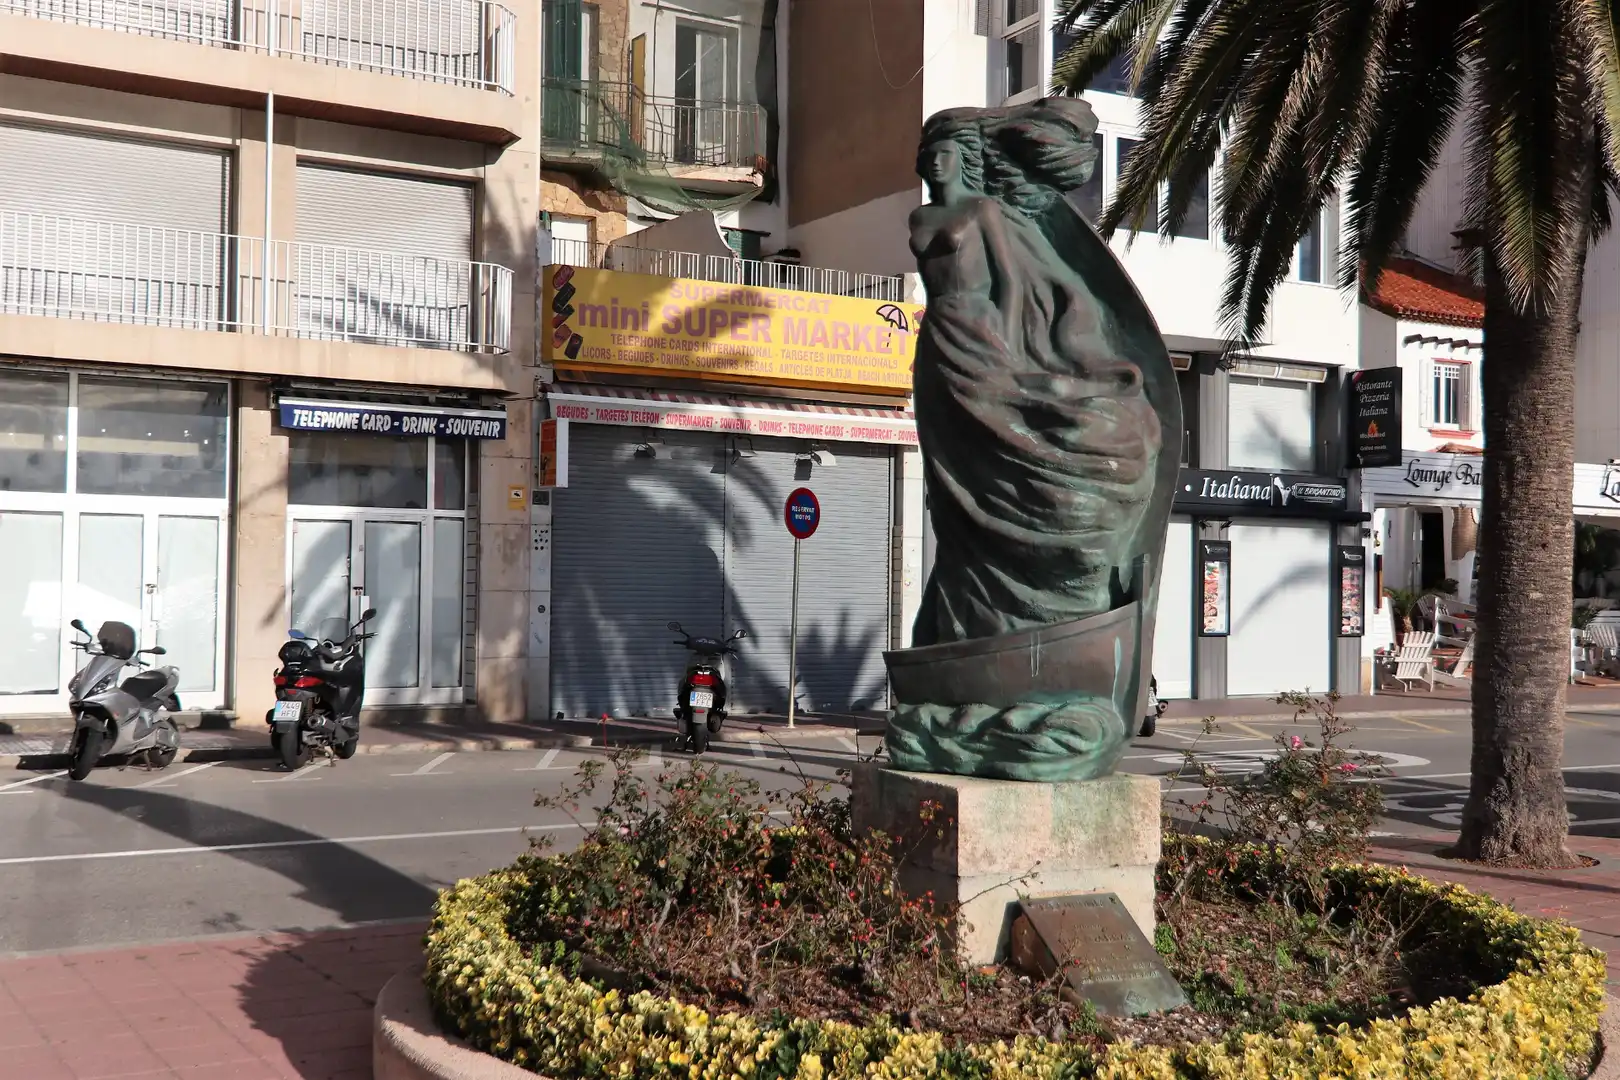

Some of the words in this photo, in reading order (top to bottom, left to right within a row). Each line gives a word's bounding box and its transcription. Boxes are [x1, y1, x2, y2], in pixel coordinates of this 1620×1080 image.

[670, 282, 832, 314] SUPERMERCAT
[578, 298, 649, 332] mini
[662, 304, 772, 343] SUPER
[783, 316, 912, 356] MARKET
[582, 346, 611, 360] LICORS
[617, 350, 654, 364] BEGUDES
[661, 354, 690, 366] DRINKS
[696, 357, 739, 370] SOUVENIRS
[744, 359, 773, 373] REGALS
[779, 363, 813, 377] ARTICLES
[815, 367, 825, 377] DE
[826, 368, 853, 379] PLATJA
[858, 370, 881, 382] BEACH
[611, 334, 667, 349] TELEPHONE
[669, 338, 700, 352] CARDS
[702, 342, 773, 359] INTERNATIONAL
[781, 348, 825, 363] TARGETES
[827, 353, 898, 370] INTERNACIONALS
[1356, 380, 1392, 392] Ristorante
[1360, 392, 1390, 403] Pizzeria
[293, 408, 359, 430] TELEPHONE
[361, 413, 391, 432] CARD
[402, 416, 437, 434] DRINK
[445, 417, 500, 438] SOUVENIR
[556, 405, 589, 420] BEGUDES
[596, 408, 630, 423] TARGETES
[666, 412, 714, 429] SUPERMARKET
[720, 416, 751, 432] SOUVENIR
[759, 420, 782, 434] DRINKS
[788, 422, 825, 436] TELEPHONE
[825, 425, 844, 438] CARDS
[850, 426, 892, 441] SUPERMERCAT
[1359, 405, 1388, 417] Italiana
[1199, 475, 1271, 500] Italiana
[1403, 458, 1453, 491] Lounge
[1455, 463, 1483, 486] Ba
